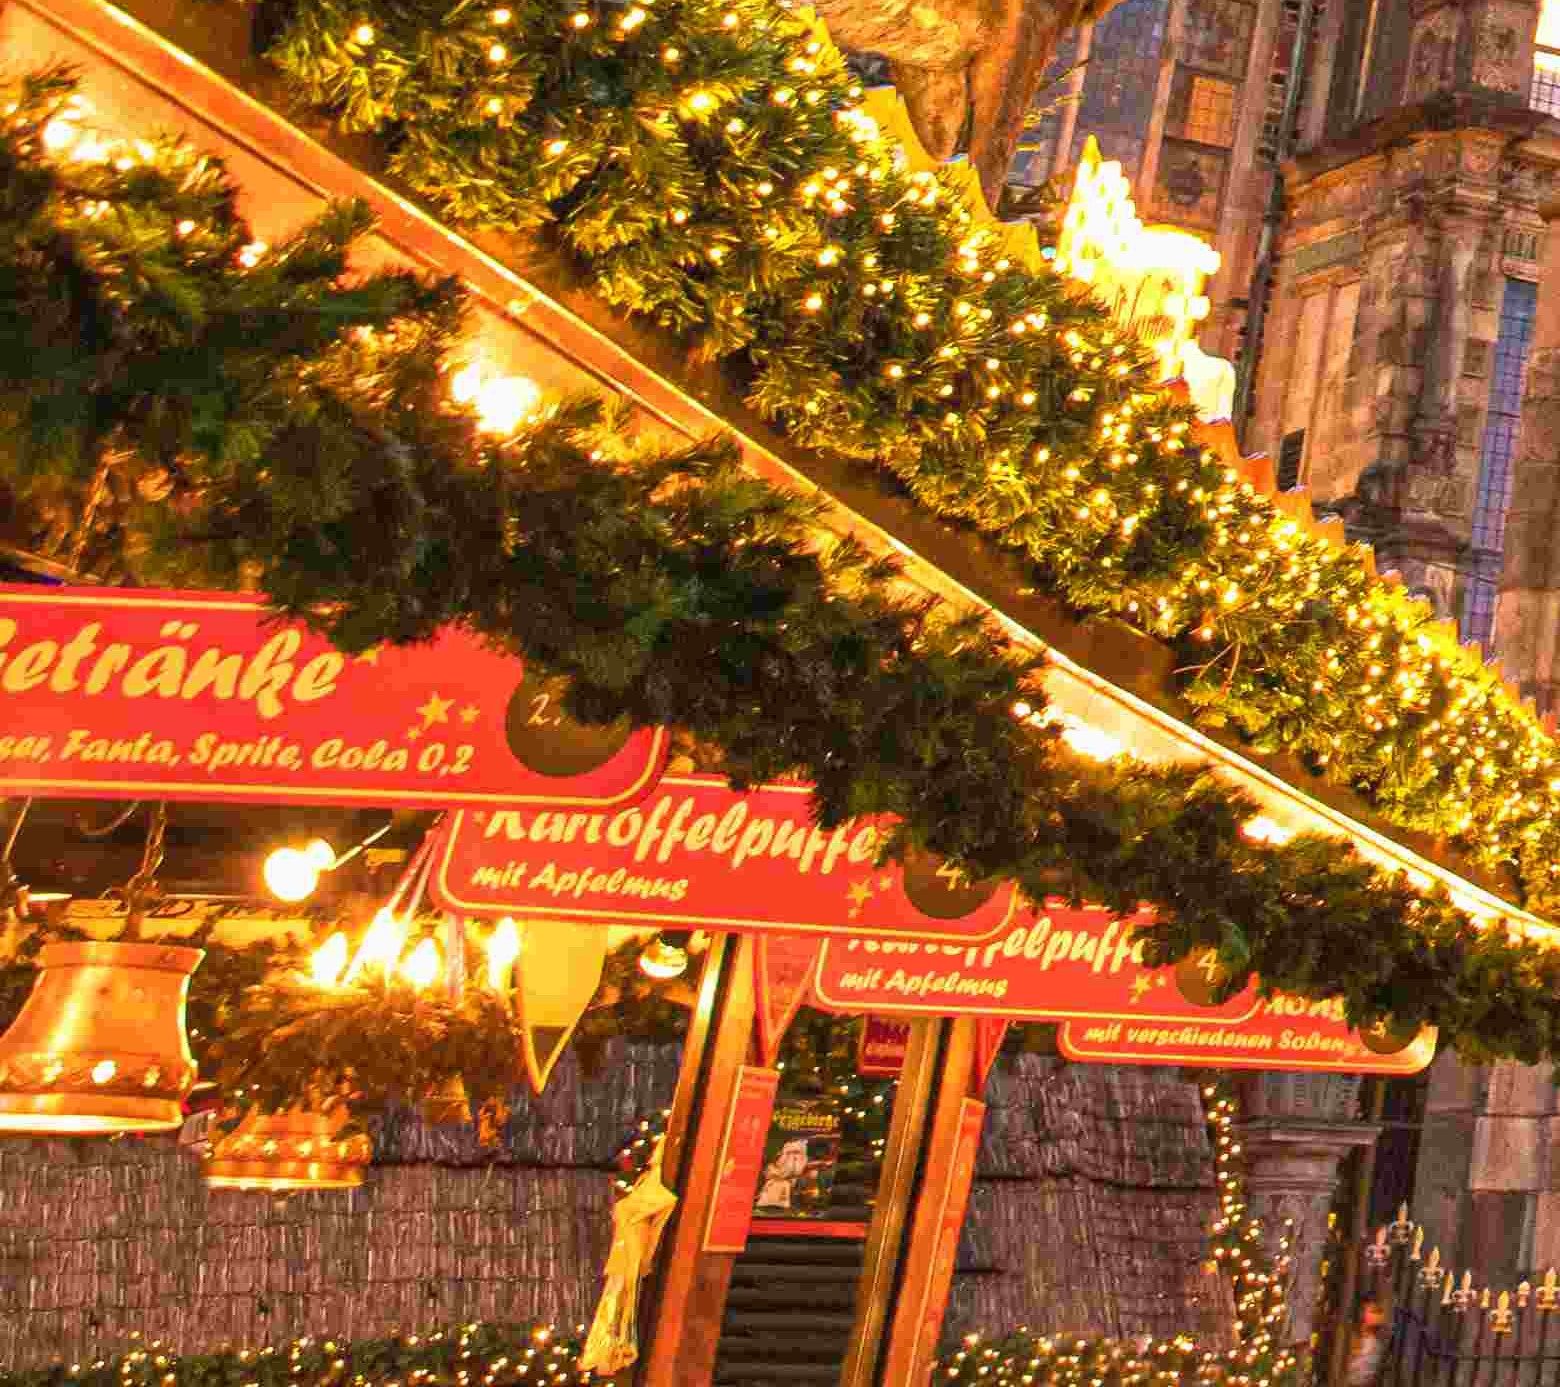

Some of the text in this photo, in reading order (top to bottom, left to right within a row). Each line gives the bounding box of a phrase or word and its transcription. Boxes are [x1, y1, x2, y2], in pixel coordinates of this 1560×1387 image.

[60, 729, 181, 768] Fanta,
[189, 731, 304, 777] Sprite,
[311, 737, 409, 773] Cola
[417, 743, 475, 775] 0,2
[484, 795, 890, 875] artoffelpuffe
[471, 861, 689, 901] mit Apfelmus
[839, 968, 1009, 999] mit Apfelmus
[1083, 1023, 1119, 1043] mit
[1127, 1025, 1273, 1051] verschiedenen
